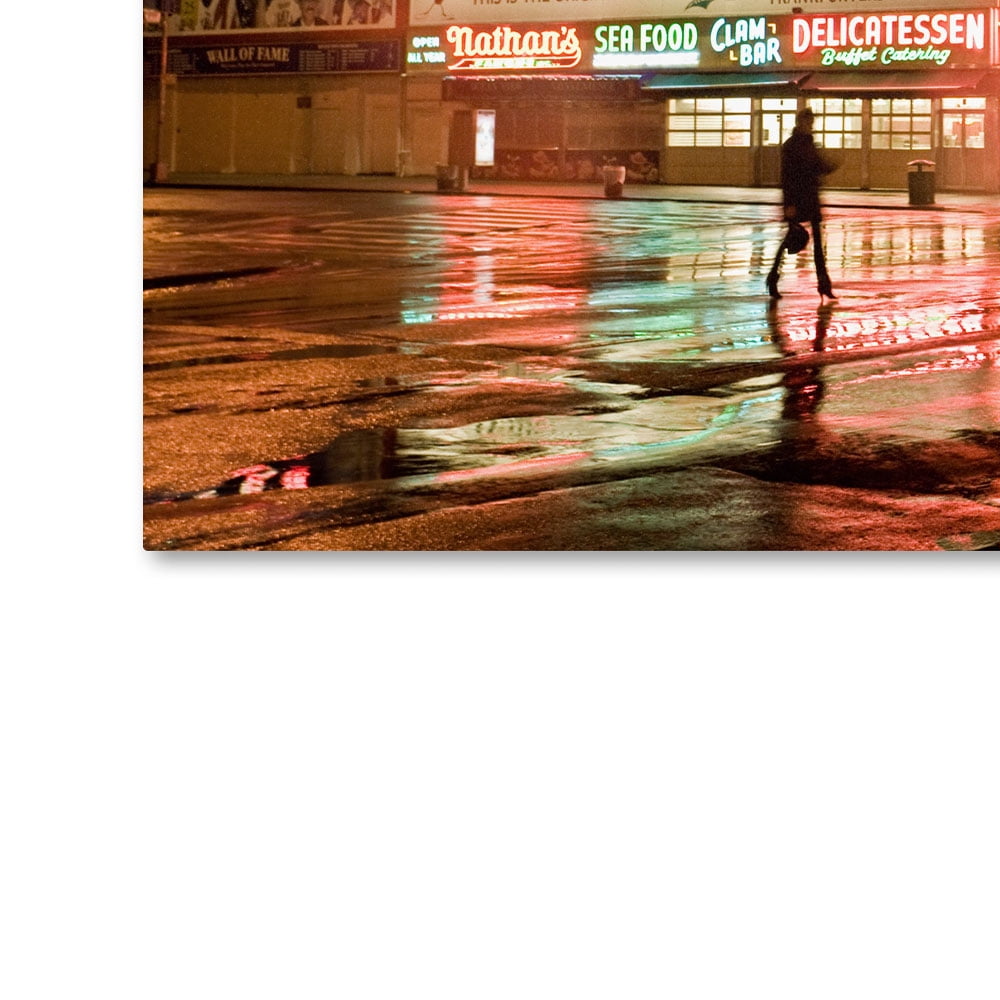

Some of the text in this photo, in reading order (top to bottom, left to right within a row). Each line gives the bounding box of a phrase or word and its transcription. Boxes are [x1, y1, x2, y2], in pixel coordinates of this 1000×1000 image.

[412, 36, 440, 49] OPEN
[446, 25, 581, 57] Nathan's
[594, 22, 698, 54] SEA FOOD
[710, 16, 766, 53] CLAM
[792, 13, 985, 54] DELICATESSEN
[206, 49, 237, 64] WALL
[238, 47, 255, 61] OF
[257, 47, 290, 62] FAME
[407, 52, 446, 63] ALL YEAR
[740, 38, 782, 67] BAR
[821, 46, 951, 67] Buffet Catering
